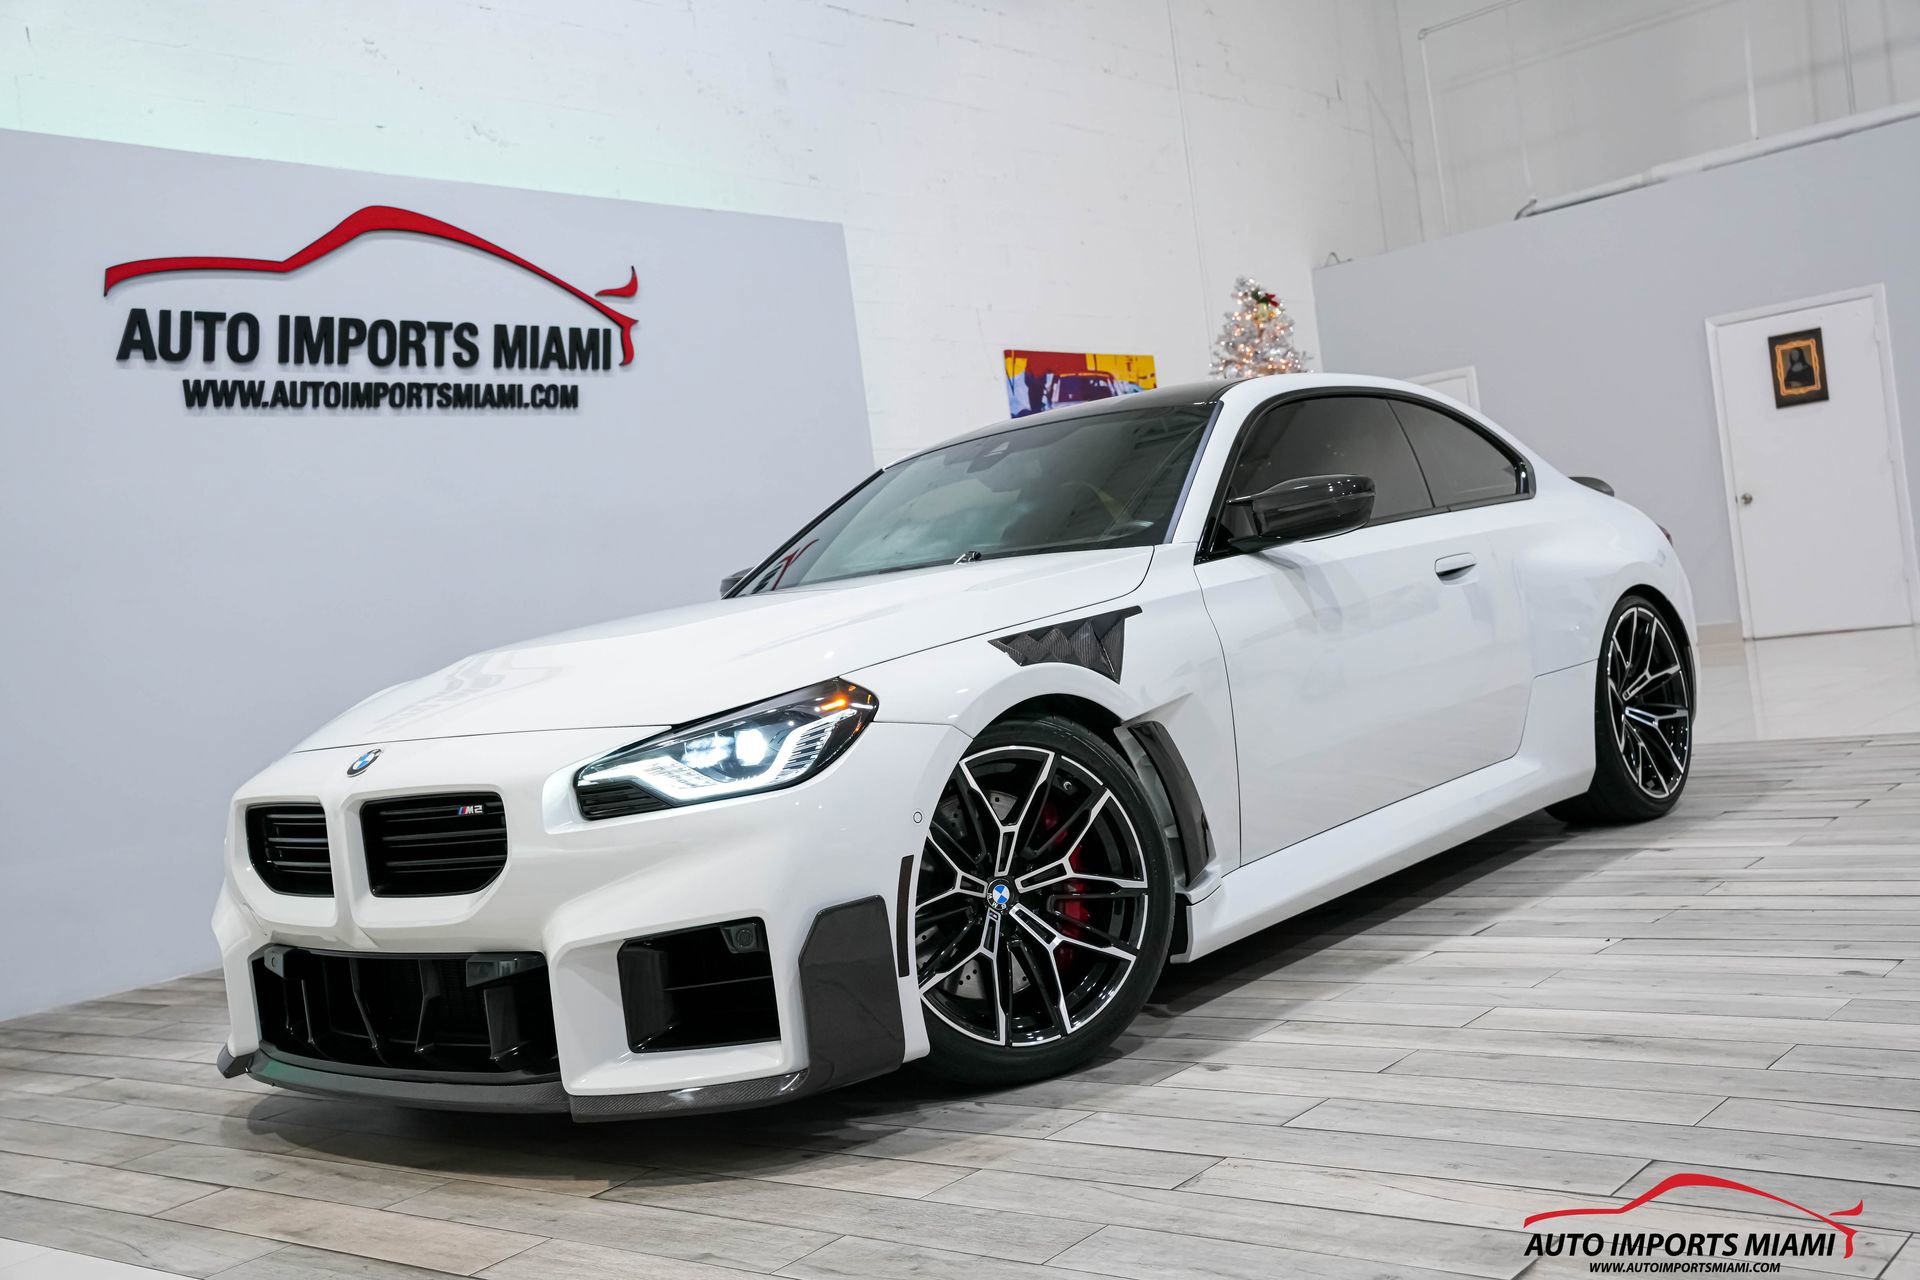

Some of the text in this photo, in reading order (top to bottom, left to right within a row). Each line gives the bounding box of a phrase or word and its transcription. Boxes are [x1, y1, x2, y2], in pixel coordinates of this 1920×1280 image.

[116, 308, 612, 371] AUTO IMPORTS MIAMI
[182, 379, 579, 409] WWW.AUTOIMPORTSMIAMI.COM
